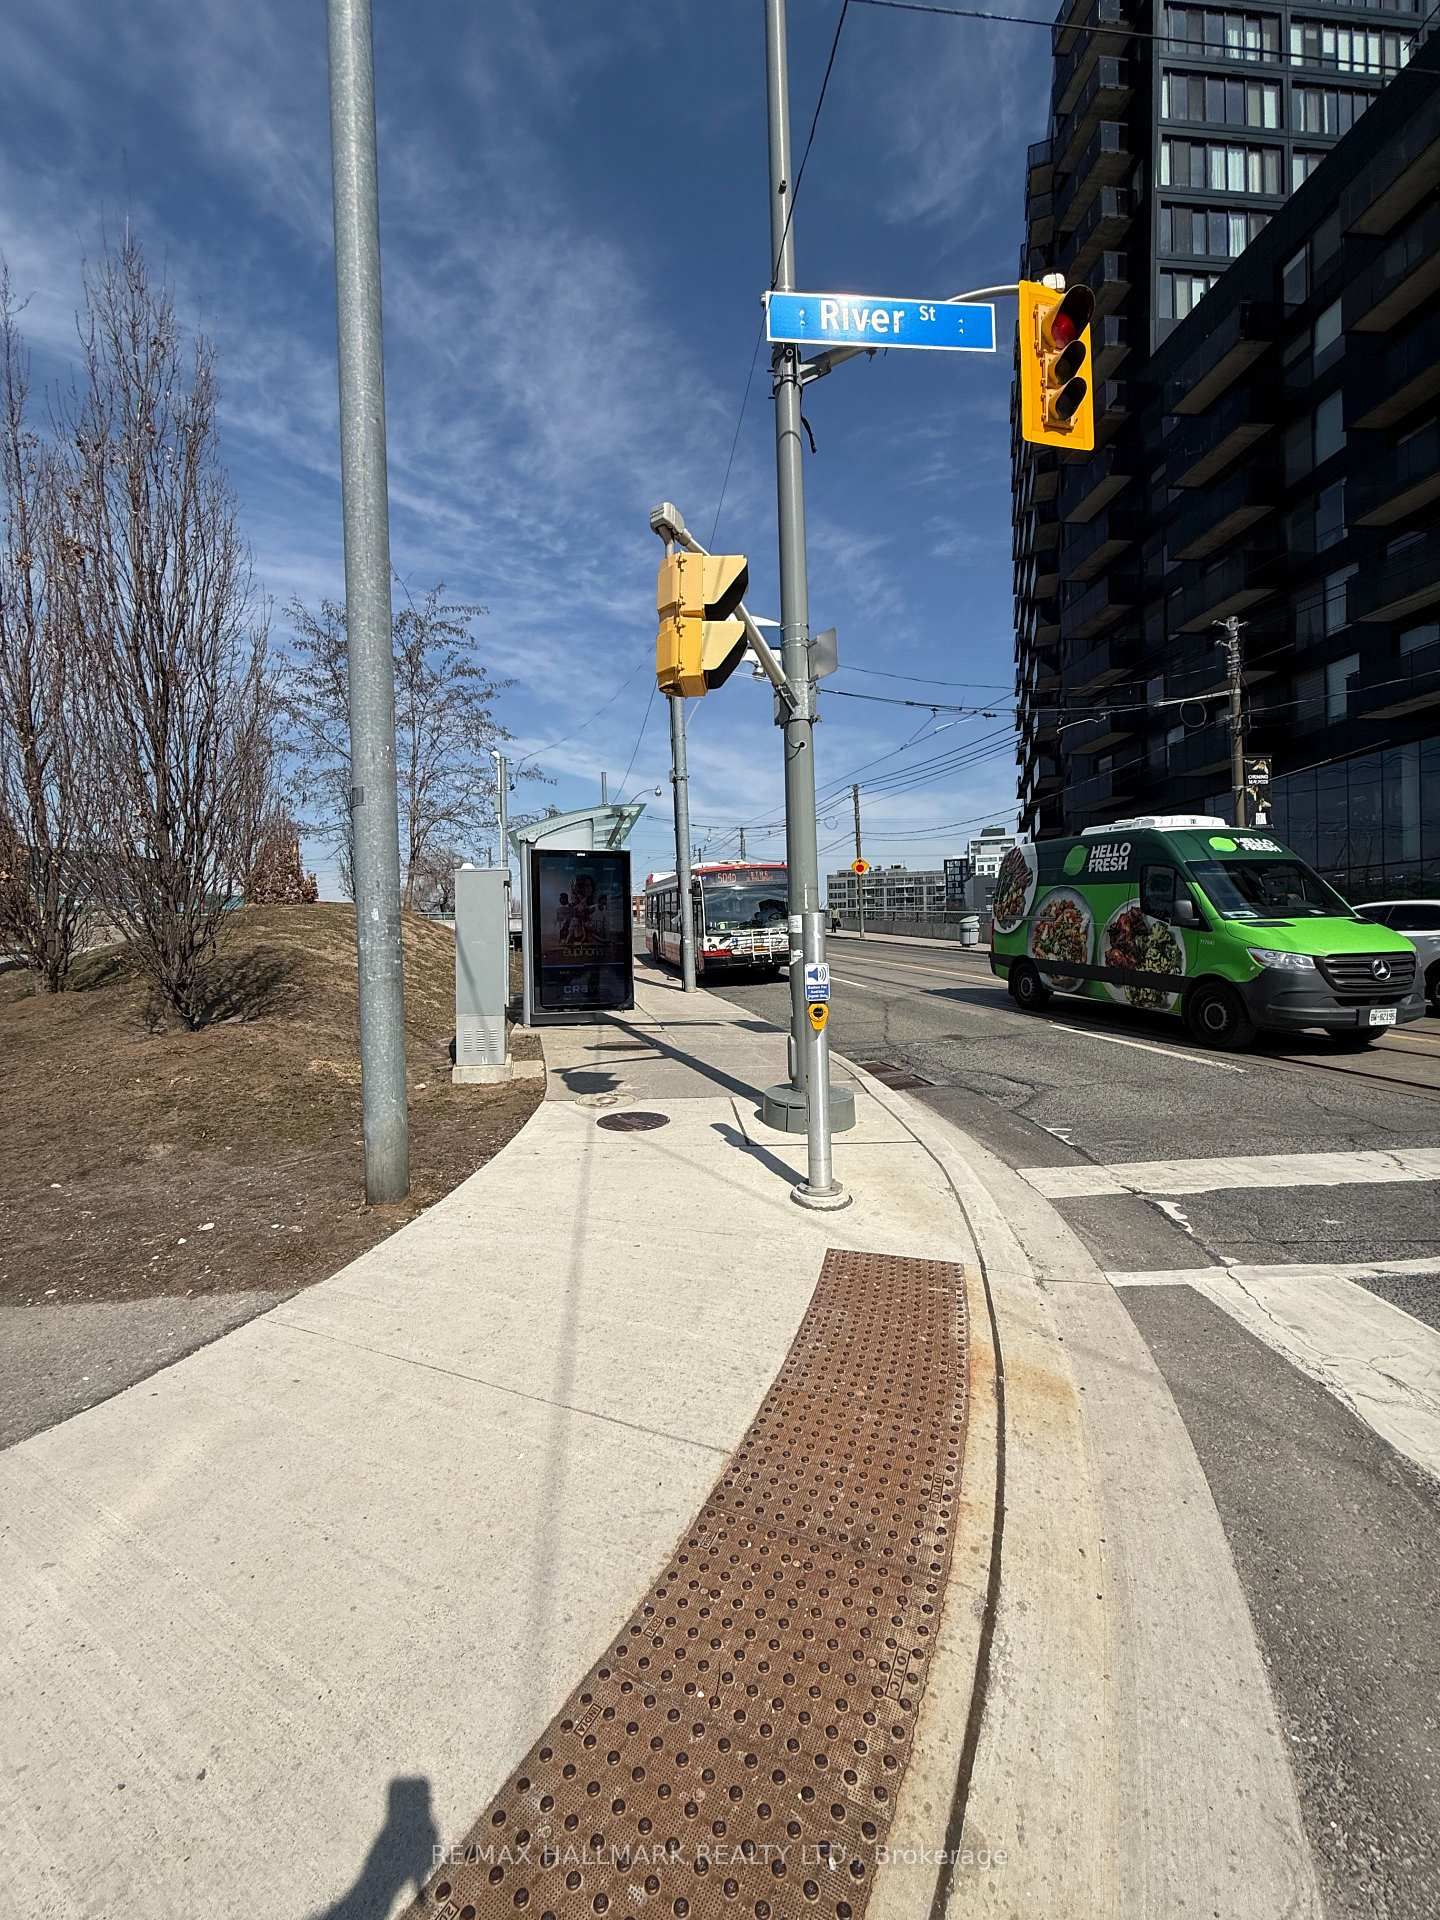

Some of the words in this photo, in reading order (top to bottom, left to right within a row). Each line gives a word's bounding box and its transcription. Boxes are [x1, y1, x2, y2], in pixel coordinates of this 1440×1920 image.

[820, 298, 904, 333] River
[919, 305, 936, 322] St
[1090, 842, 1132, 859] HELLO
[1088, 857, 1129, 873] FRESH
[576, 1706, 599, 1732] INDIA
